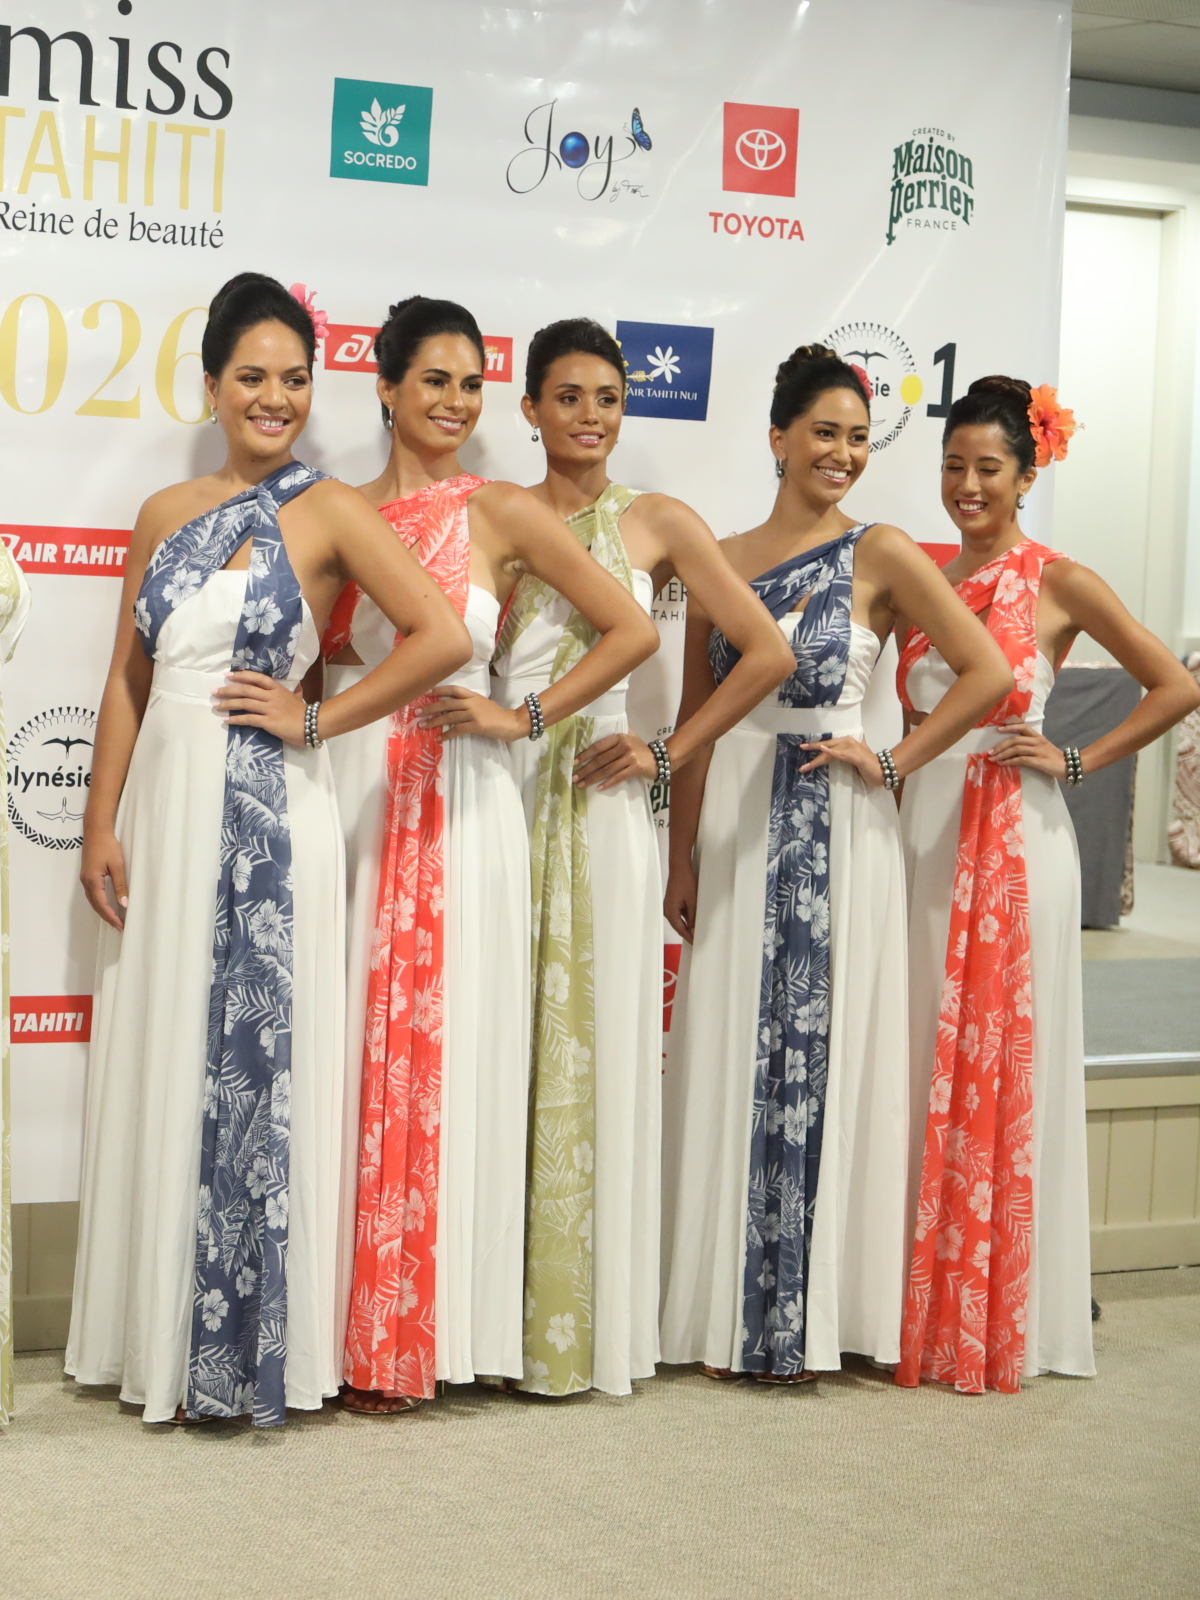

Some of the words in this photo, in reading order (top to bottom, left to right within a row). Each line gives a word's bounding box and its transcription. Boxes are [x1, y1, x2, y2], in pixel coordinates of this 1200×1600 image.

[912, 127, 945, 137] CREATED
[947, 133, 956, 143] BY
[343, 150, 417, 170] SOCREDO
[892, 136, 974, 190] Maison
[84, 208, 119, 239] de
[129, 211, 224, 249] beauté
[709, 212, 805, 241] TOYOTA
[907, 218, 957, 230] FRANCE
[926, 342, 956, 418] 1
[628, 387, 645, 397] AIR
[646, 388, 678, 399] TAHITI
[680, 391, 698, 401] NUI
[16, 542, 57, 563] AIR
[63, 544, 130, 566] TAHIT
[652, 610, 685, 621] TAHI
[13, 1012, 84, 1032] TAHITI
